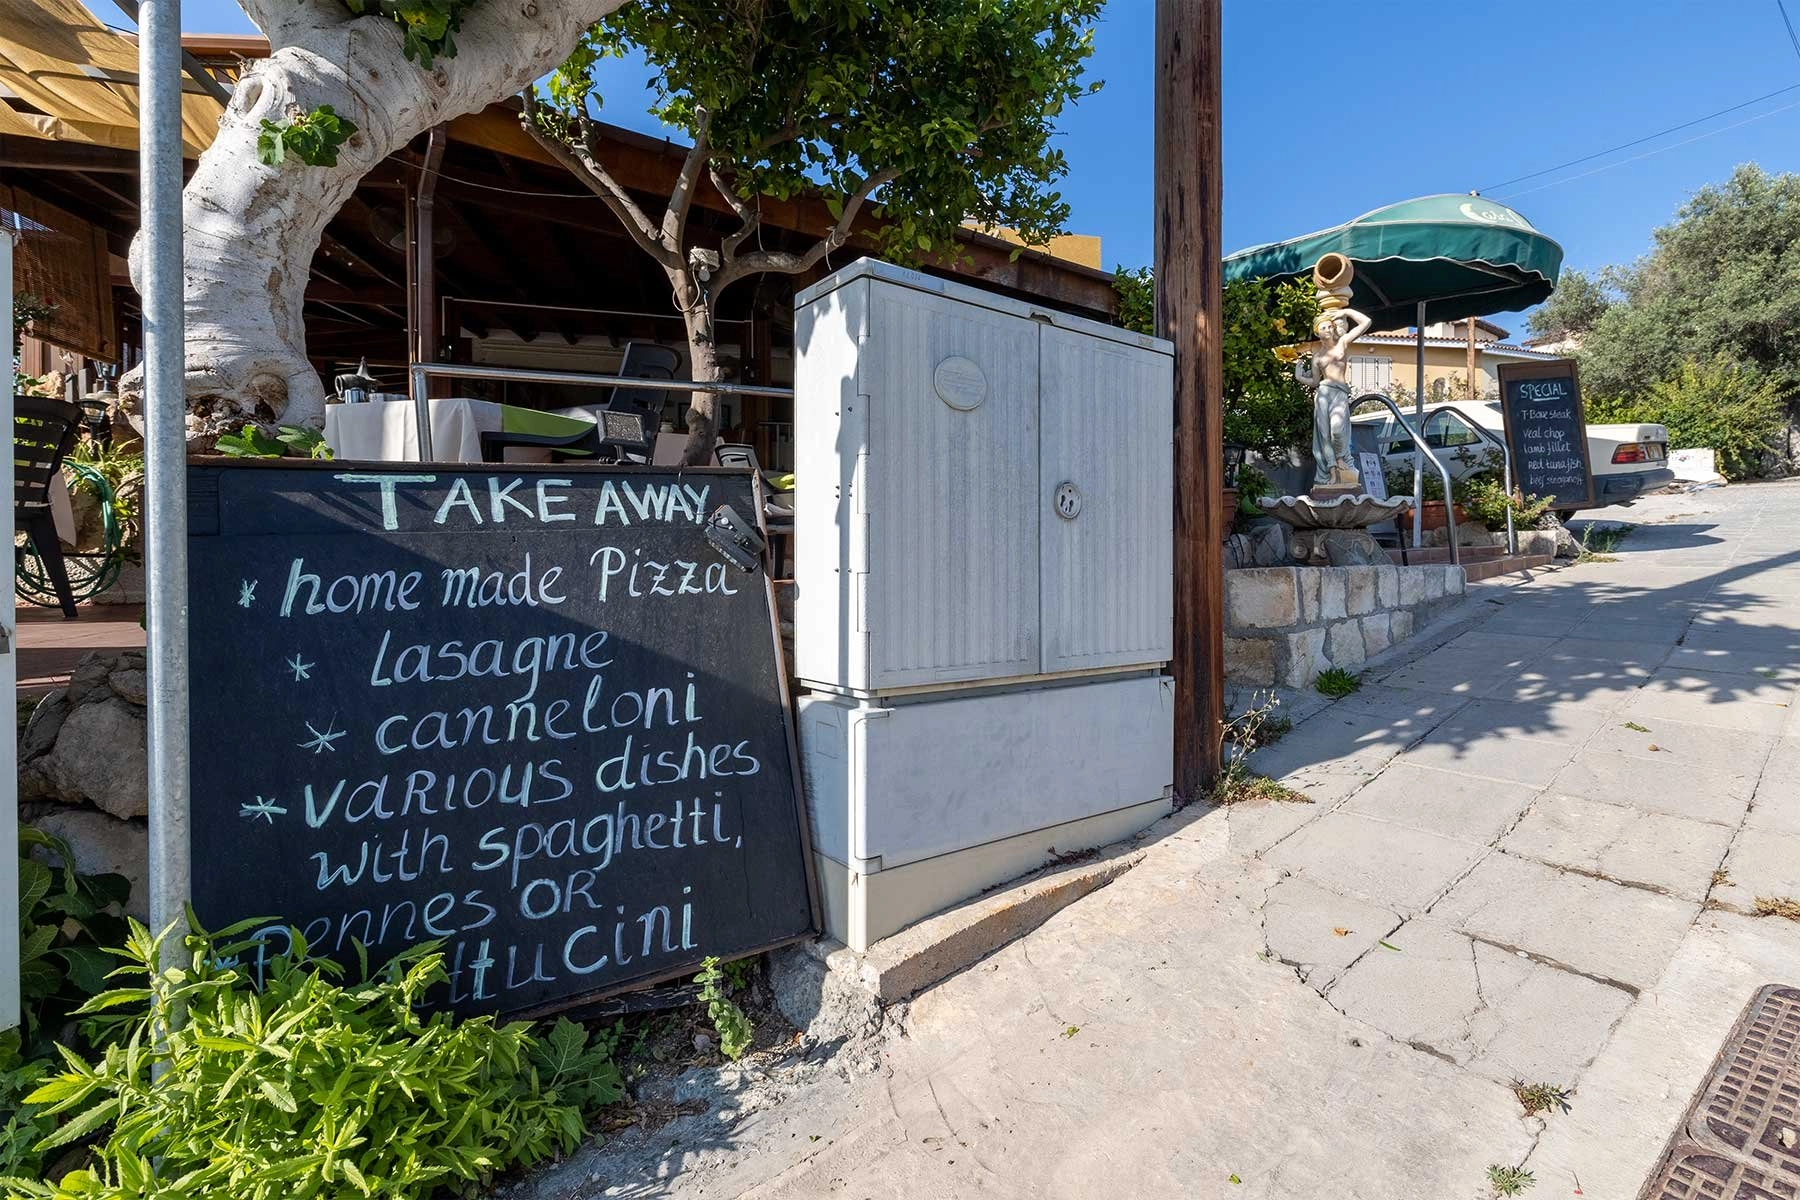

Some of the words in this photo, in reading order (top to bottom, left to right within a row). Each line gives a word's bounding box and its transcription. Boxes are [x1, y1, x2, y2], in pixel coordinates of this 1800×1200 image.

[1520, 383, 1567, 399] SPECIAL
[1544, 426, 1565, 441] chop
[1547, 441, 1571, 456] fillet
[334, 473, 577, 531] TAKE
[594, 479, 711, 526] AWAY
[279, 557, 422, 618] home
[440, 552, 567, 609] made
[590, 546, 739, 603] Pizza
[595, 733, 762, 793] dishes
[309, 827, 454, 891] with
